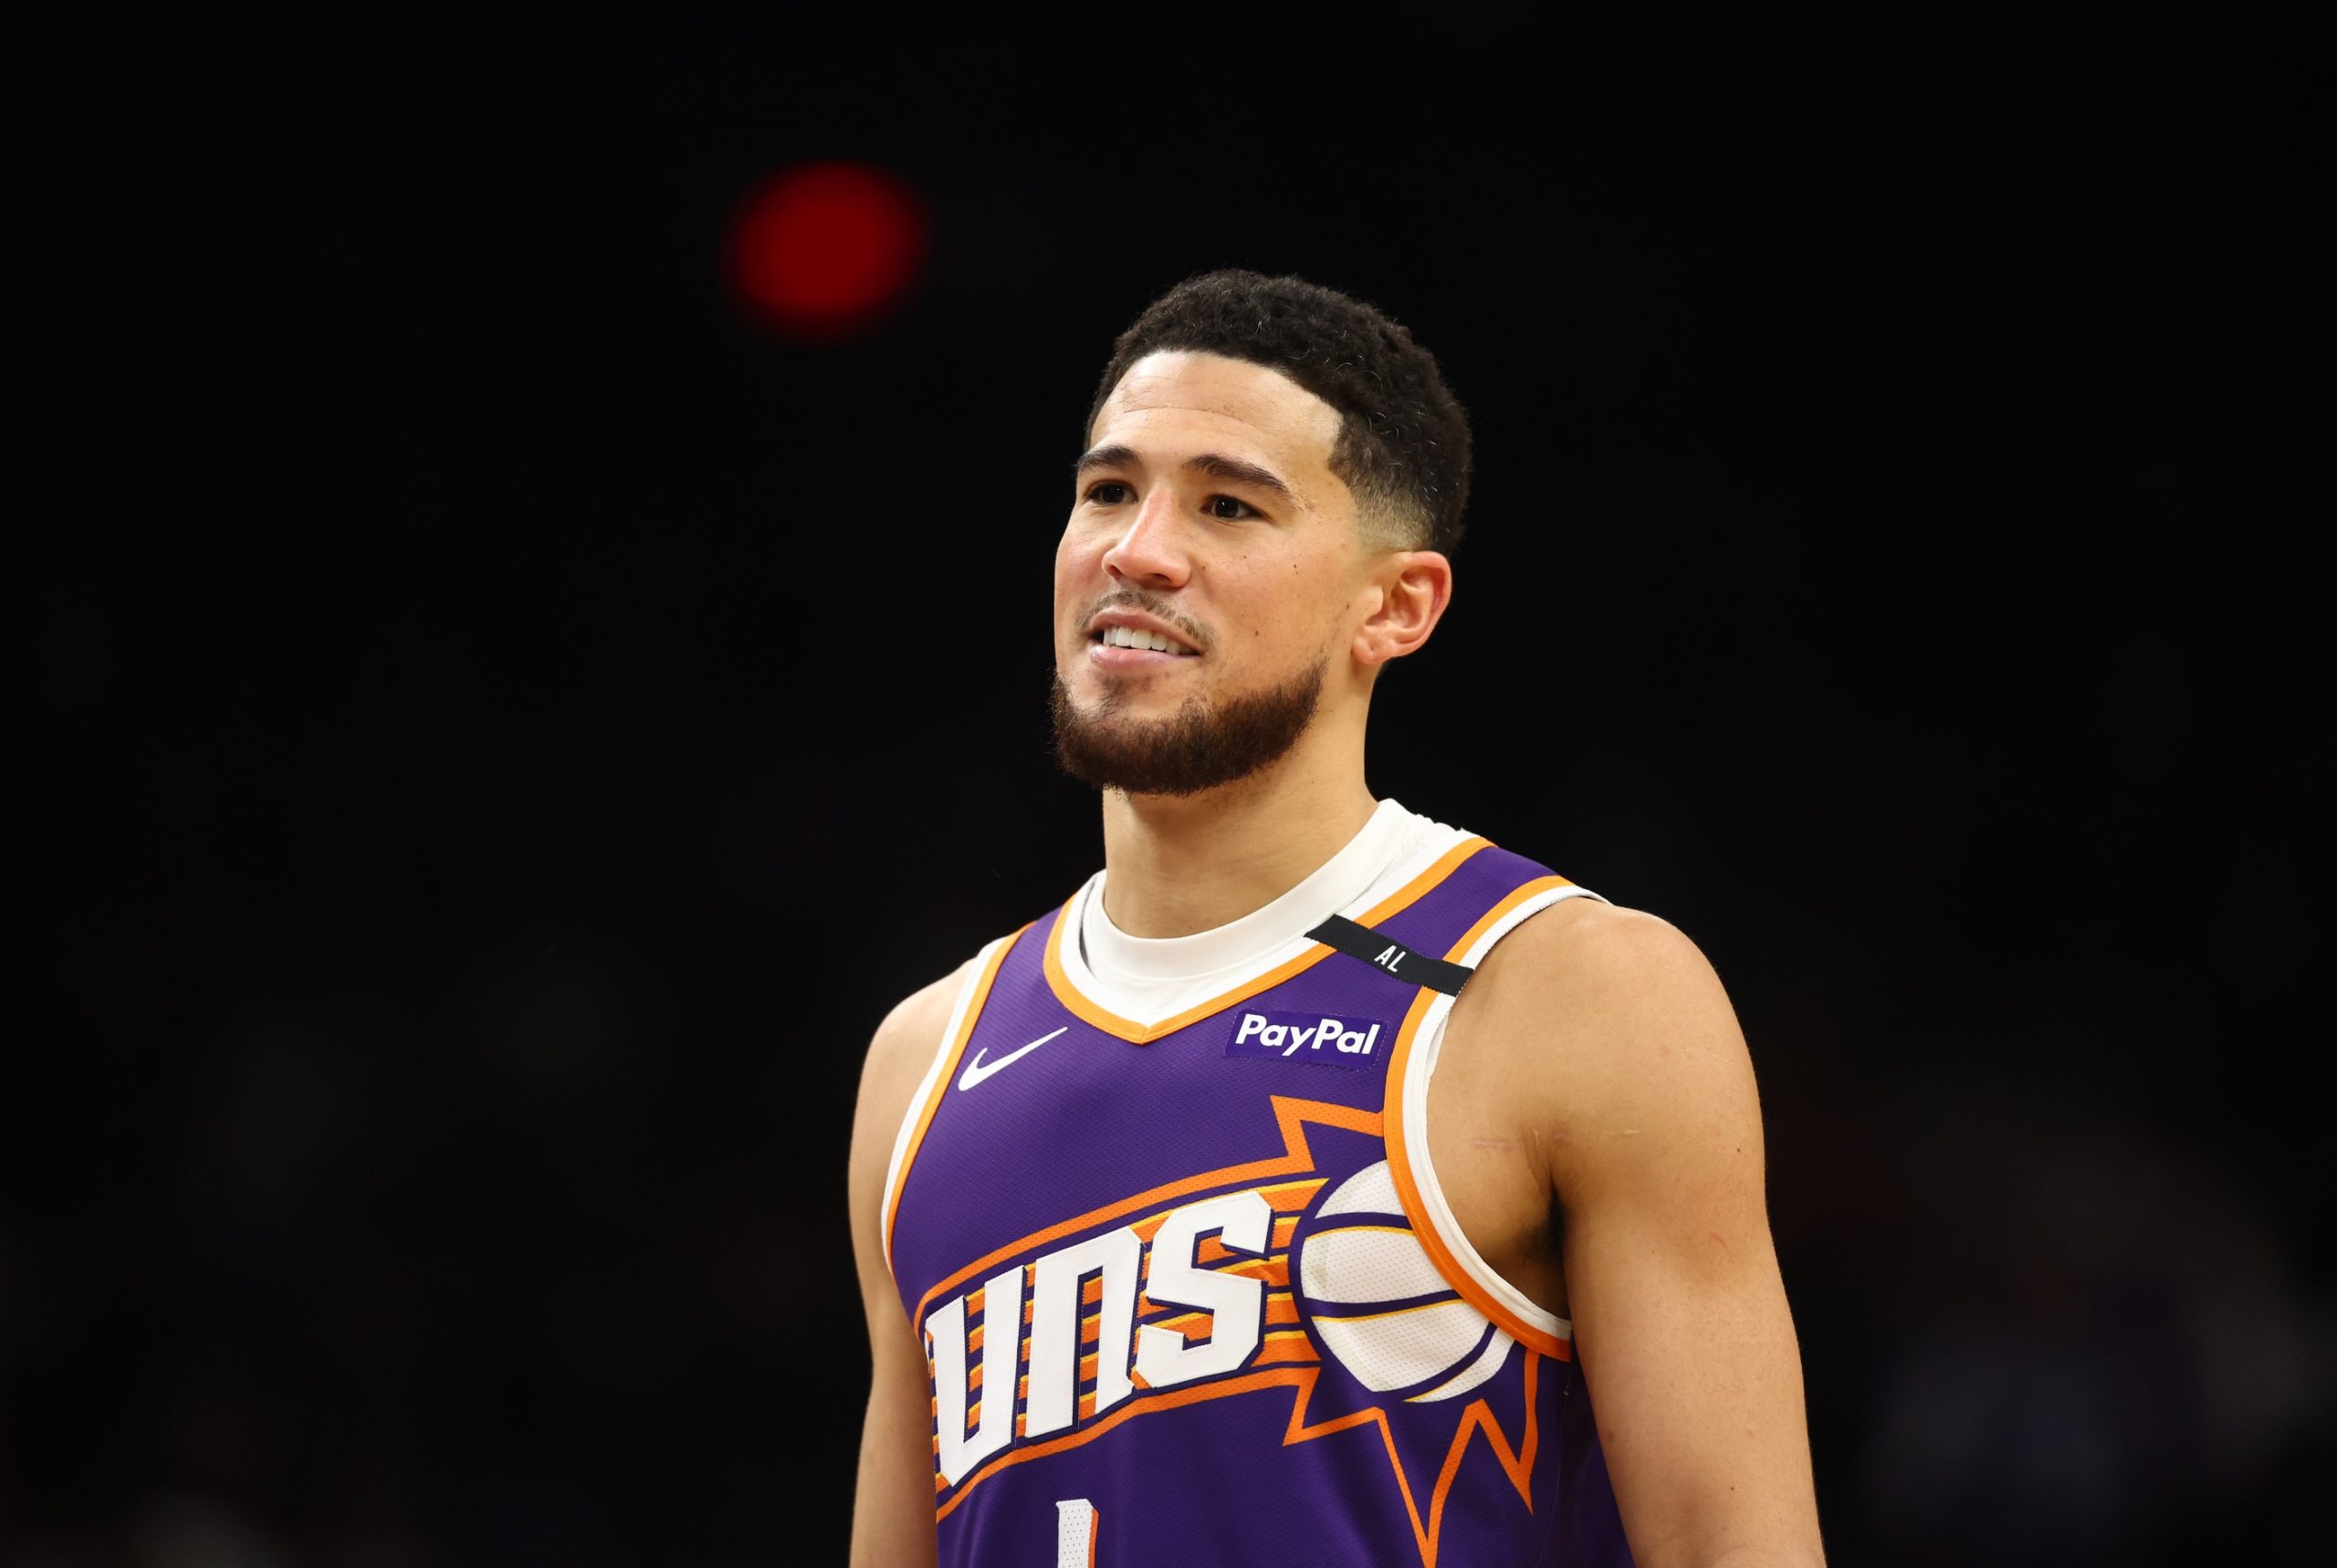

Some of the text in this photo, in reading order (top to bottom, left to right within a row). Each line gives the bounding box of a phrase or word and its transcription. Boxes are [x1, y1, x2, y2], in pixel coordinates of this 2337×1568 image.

[1374, 945, 1406, 973] AL
[1235, 1013, 1380, 1057] PayPal
[925, 1190, 1276, 1493] UNS
